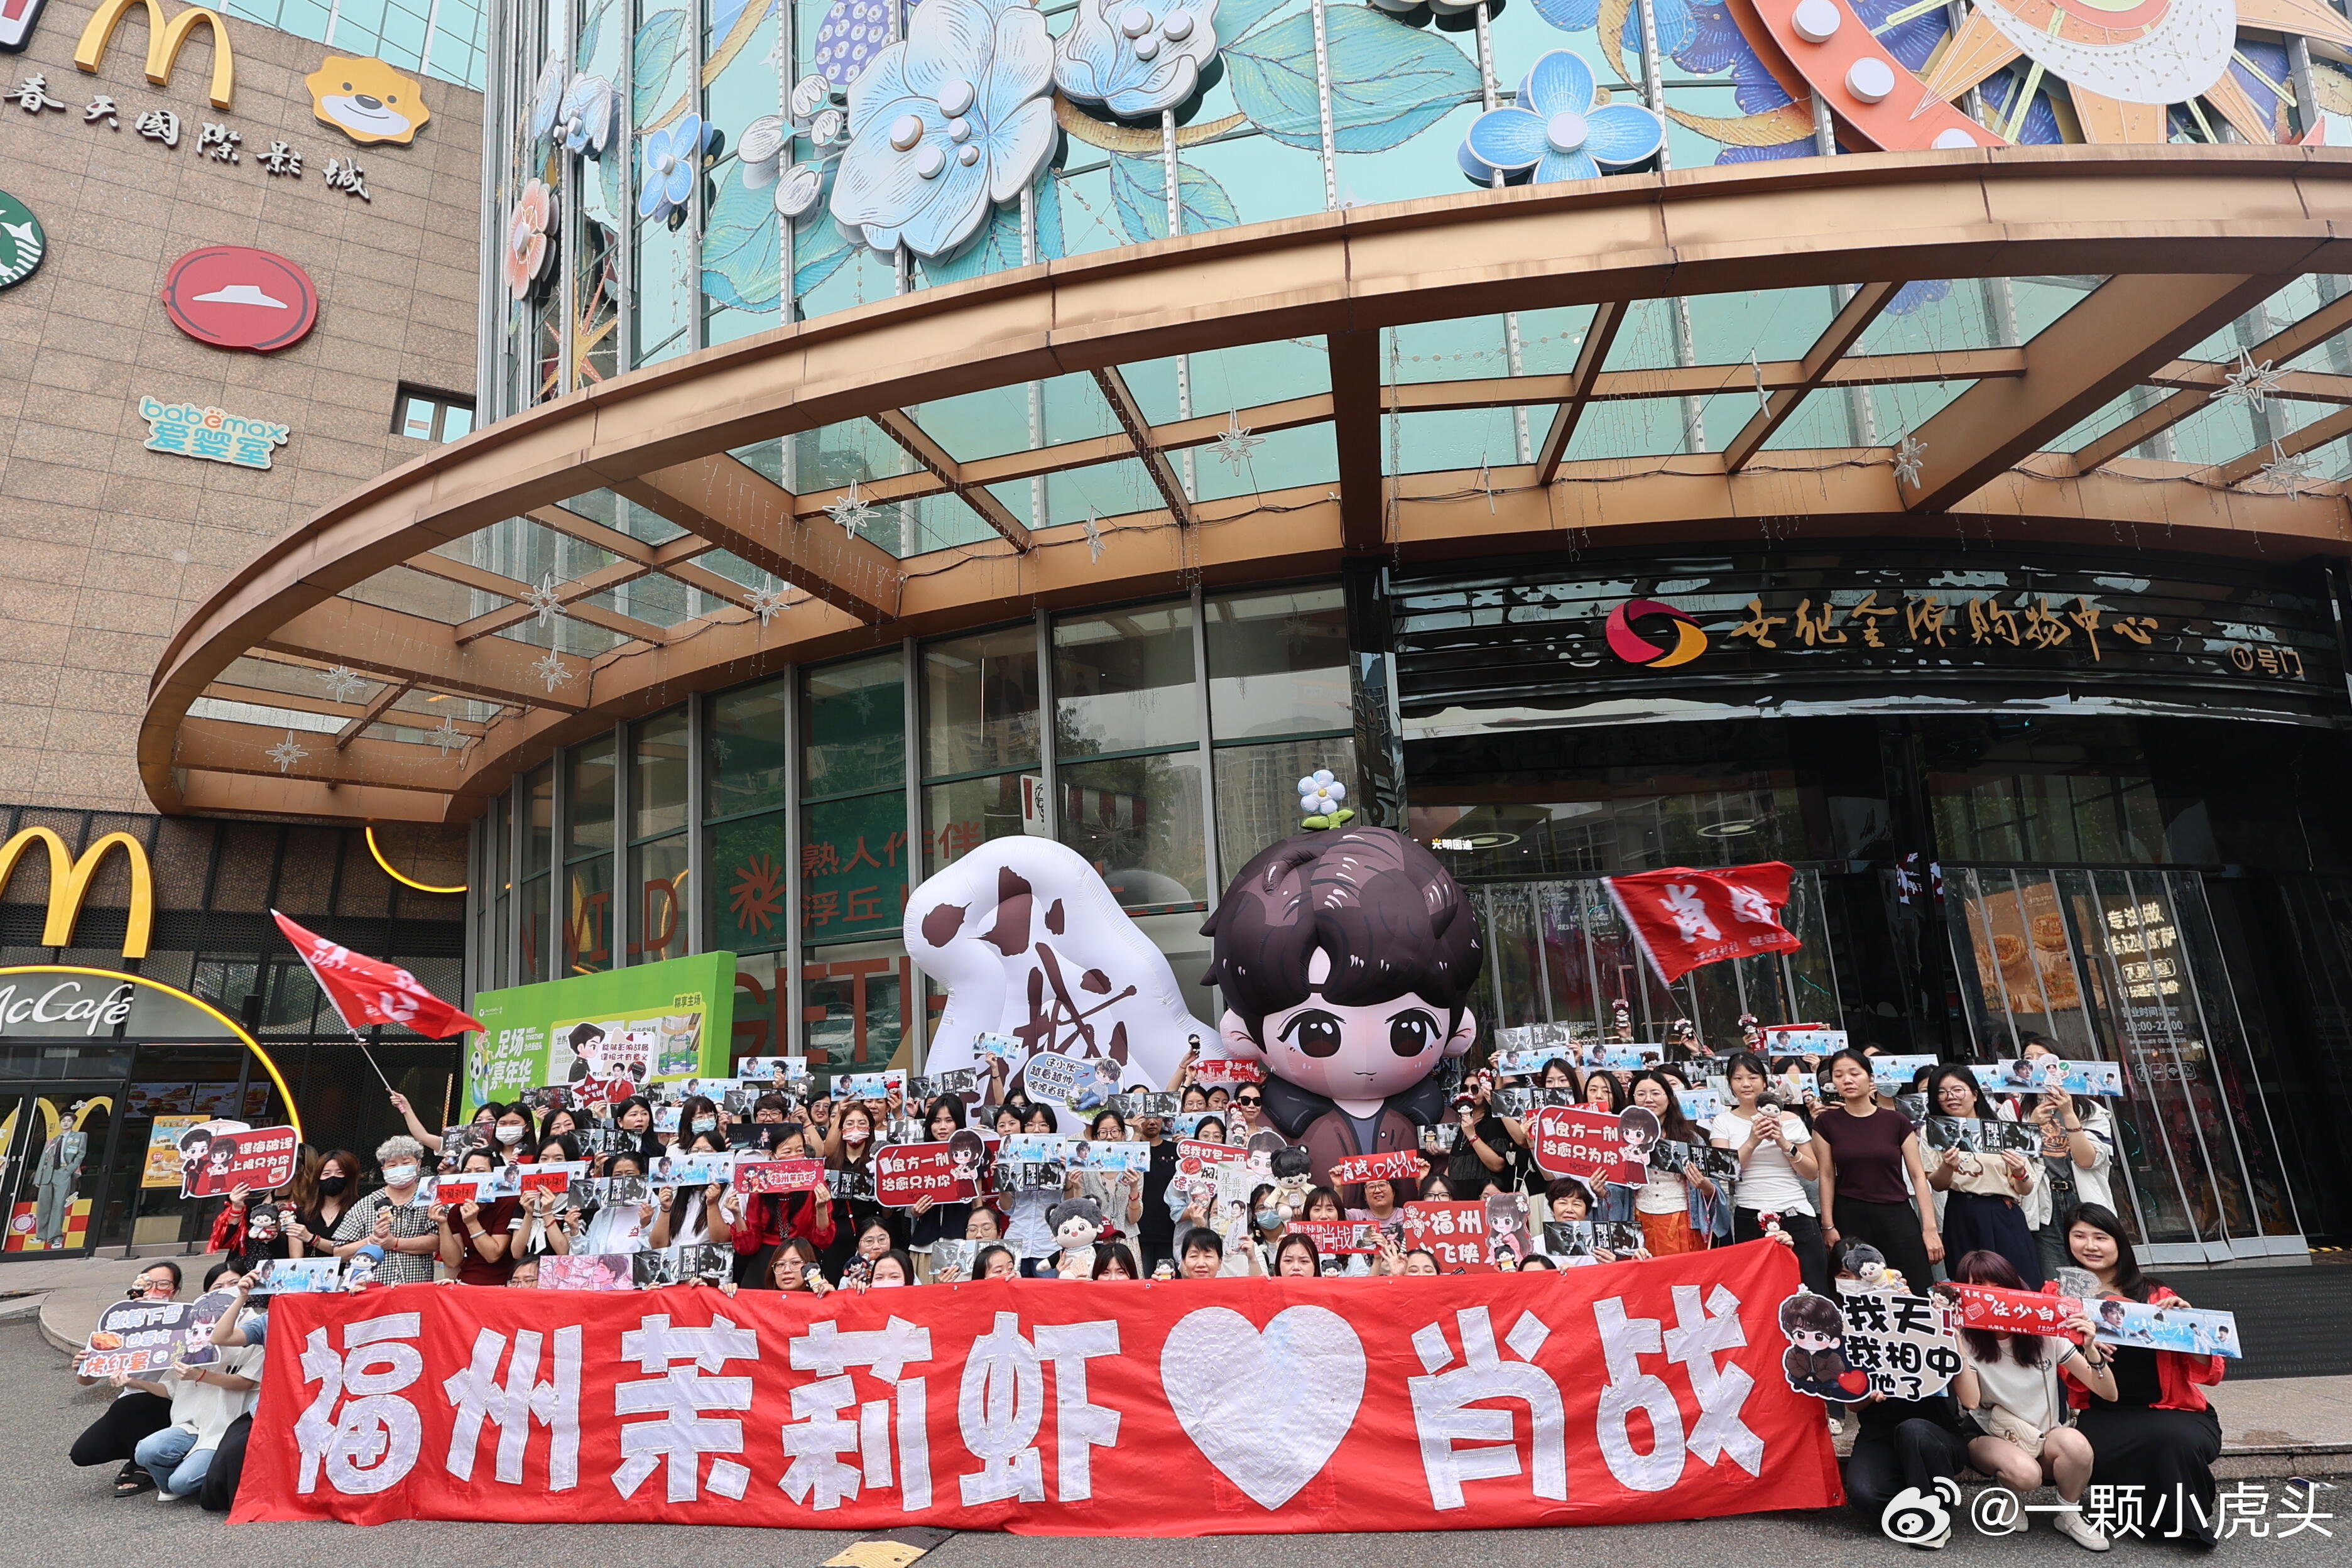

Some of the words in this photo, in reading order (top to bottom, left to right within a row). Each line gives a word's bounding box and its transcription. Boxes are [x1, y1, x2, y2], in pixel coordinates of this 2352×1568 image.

[149, 422, 273, 466] 爱婴室
[1030, 1065, 1074, 1085] 越看越帅
[1179, 1143, 1246, 1162] 给我打包一份
[1542, 1140, 1618, 1165] 治愈只为你
[881, 1174, 951, 1192] 治愈只为你
[1430, 1209, 1483, 1236] 福州
[1322, 1224, 1353, 1252] 肖战
[105, 1304, 184, 1330] 就算下雪
[126, 1329, 172, 1348] 也要吃
[82, 1350, 152, 1376] 烤红薯
[1847, 1335, 1962, 1379] 我相中
[293, 1310, 1121, 1511] 福州茉莉虾
[1408, 1283, 1765, 1511] 肖战
[1869, 1373, 1923, 1400] 他了
